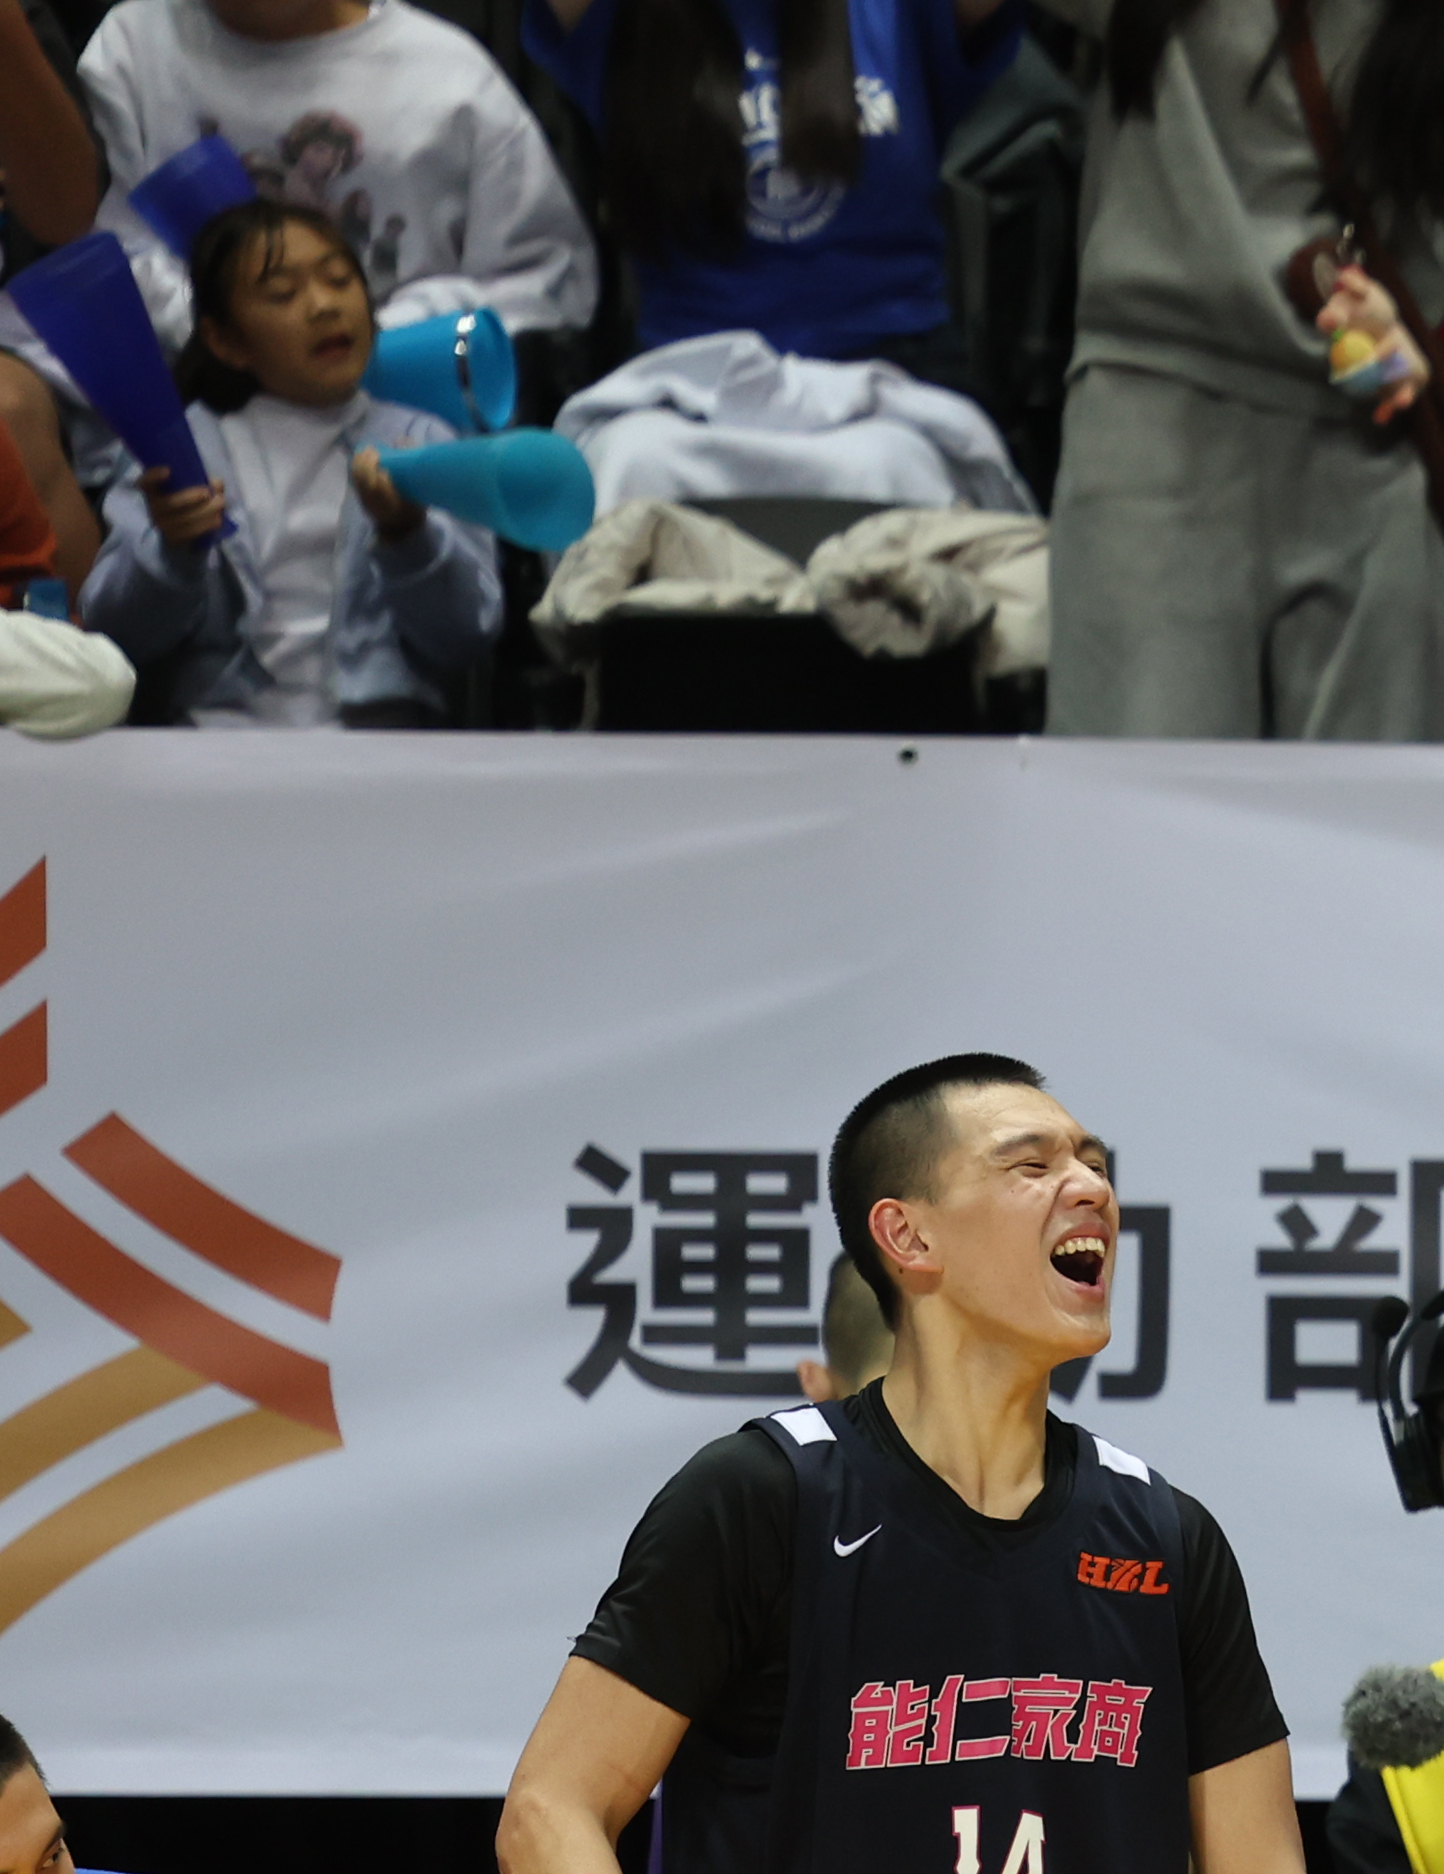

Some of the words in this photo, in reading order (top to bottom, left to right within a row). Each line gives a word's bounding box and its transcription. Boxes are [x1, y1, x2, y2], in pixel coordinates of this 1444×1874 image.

[1077, 1551, 1170, 1594] HBL
[845, 1673, 1153, 1770] 能仁家商
